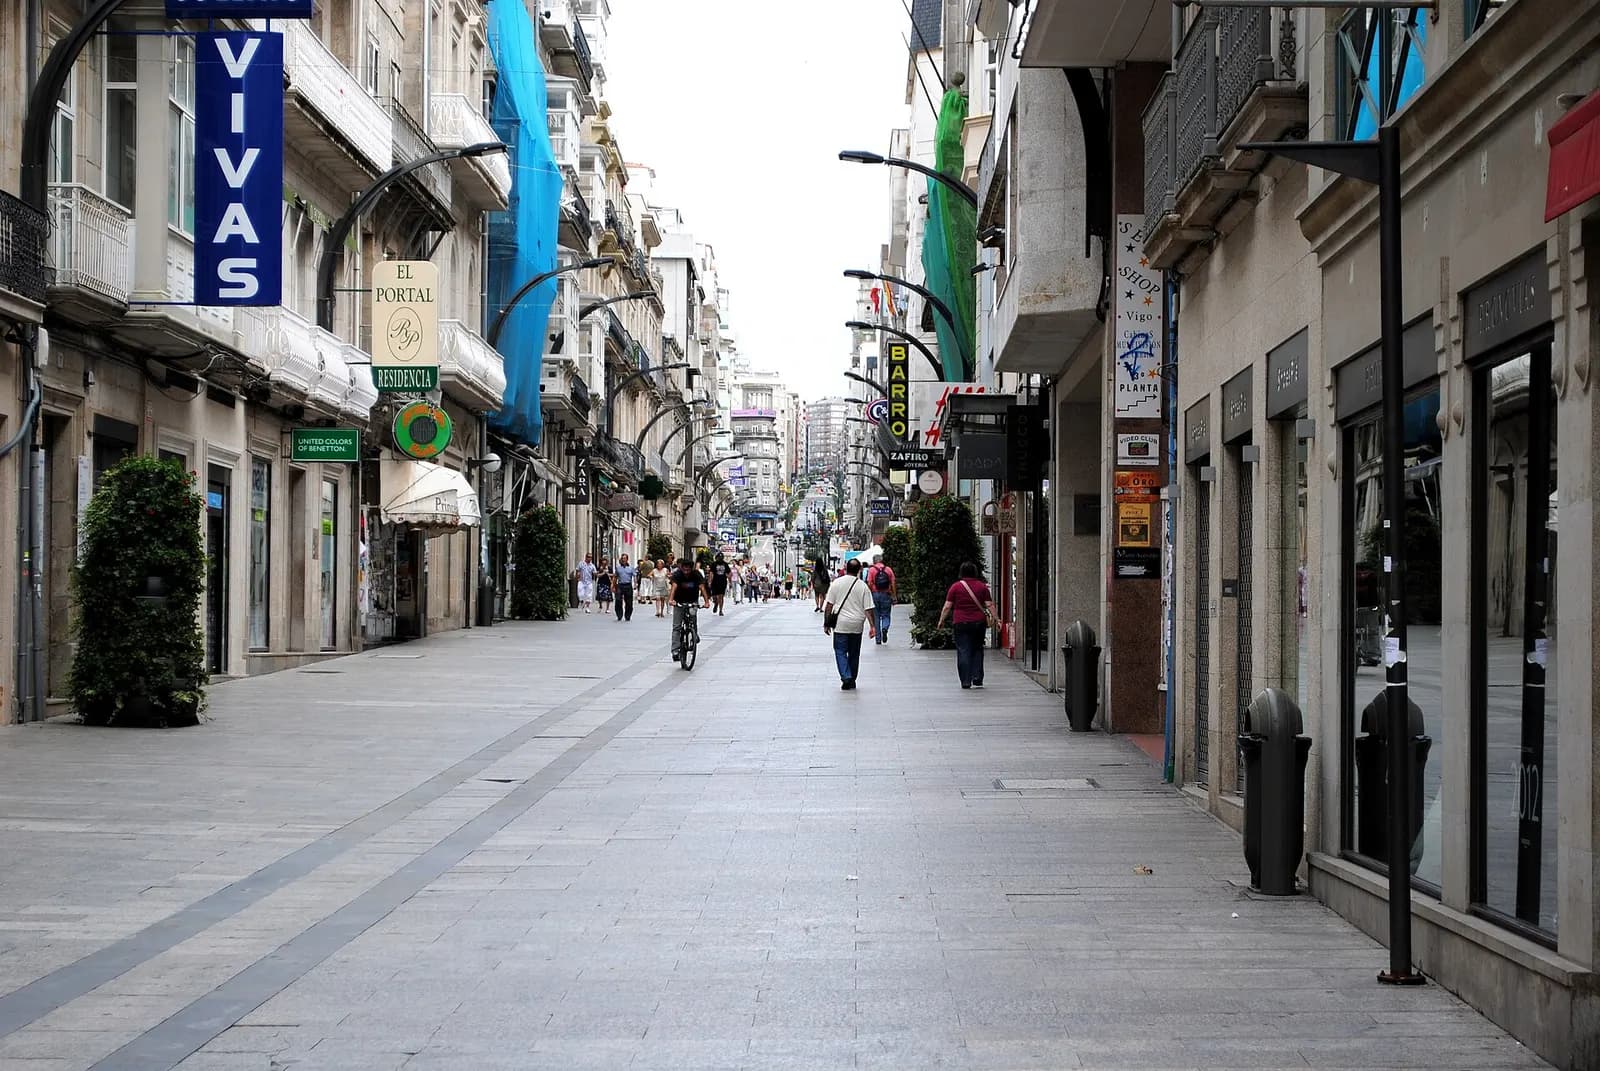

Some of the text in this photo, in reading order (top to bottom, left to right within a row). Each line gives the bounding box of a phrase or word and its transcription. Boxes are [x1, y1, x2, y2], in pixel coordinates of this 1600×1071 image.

[212, 38, 261, 298] VIVAS
[397, 264, 413, 279] EL
[1119, 266, 1161, 294] SHOP
[375, 287, 434, 303] PORTAL
[1126, 311, 1153, 322] Vigo
[378, 369, 431, 388] RESIDENCIA
[891, 346, 906, 436] BARRO
[1119, 383, 1159, 393] PLANTA
[1119, 435, 1158, 445] VIDEO CLUB
[890, 452, 929, 461] ZAFIRO
[577, 458, 587, 496] ZARA
[1133, 477, 1154, 486] ORO
[1511, 761, 1538, 822] 2012
